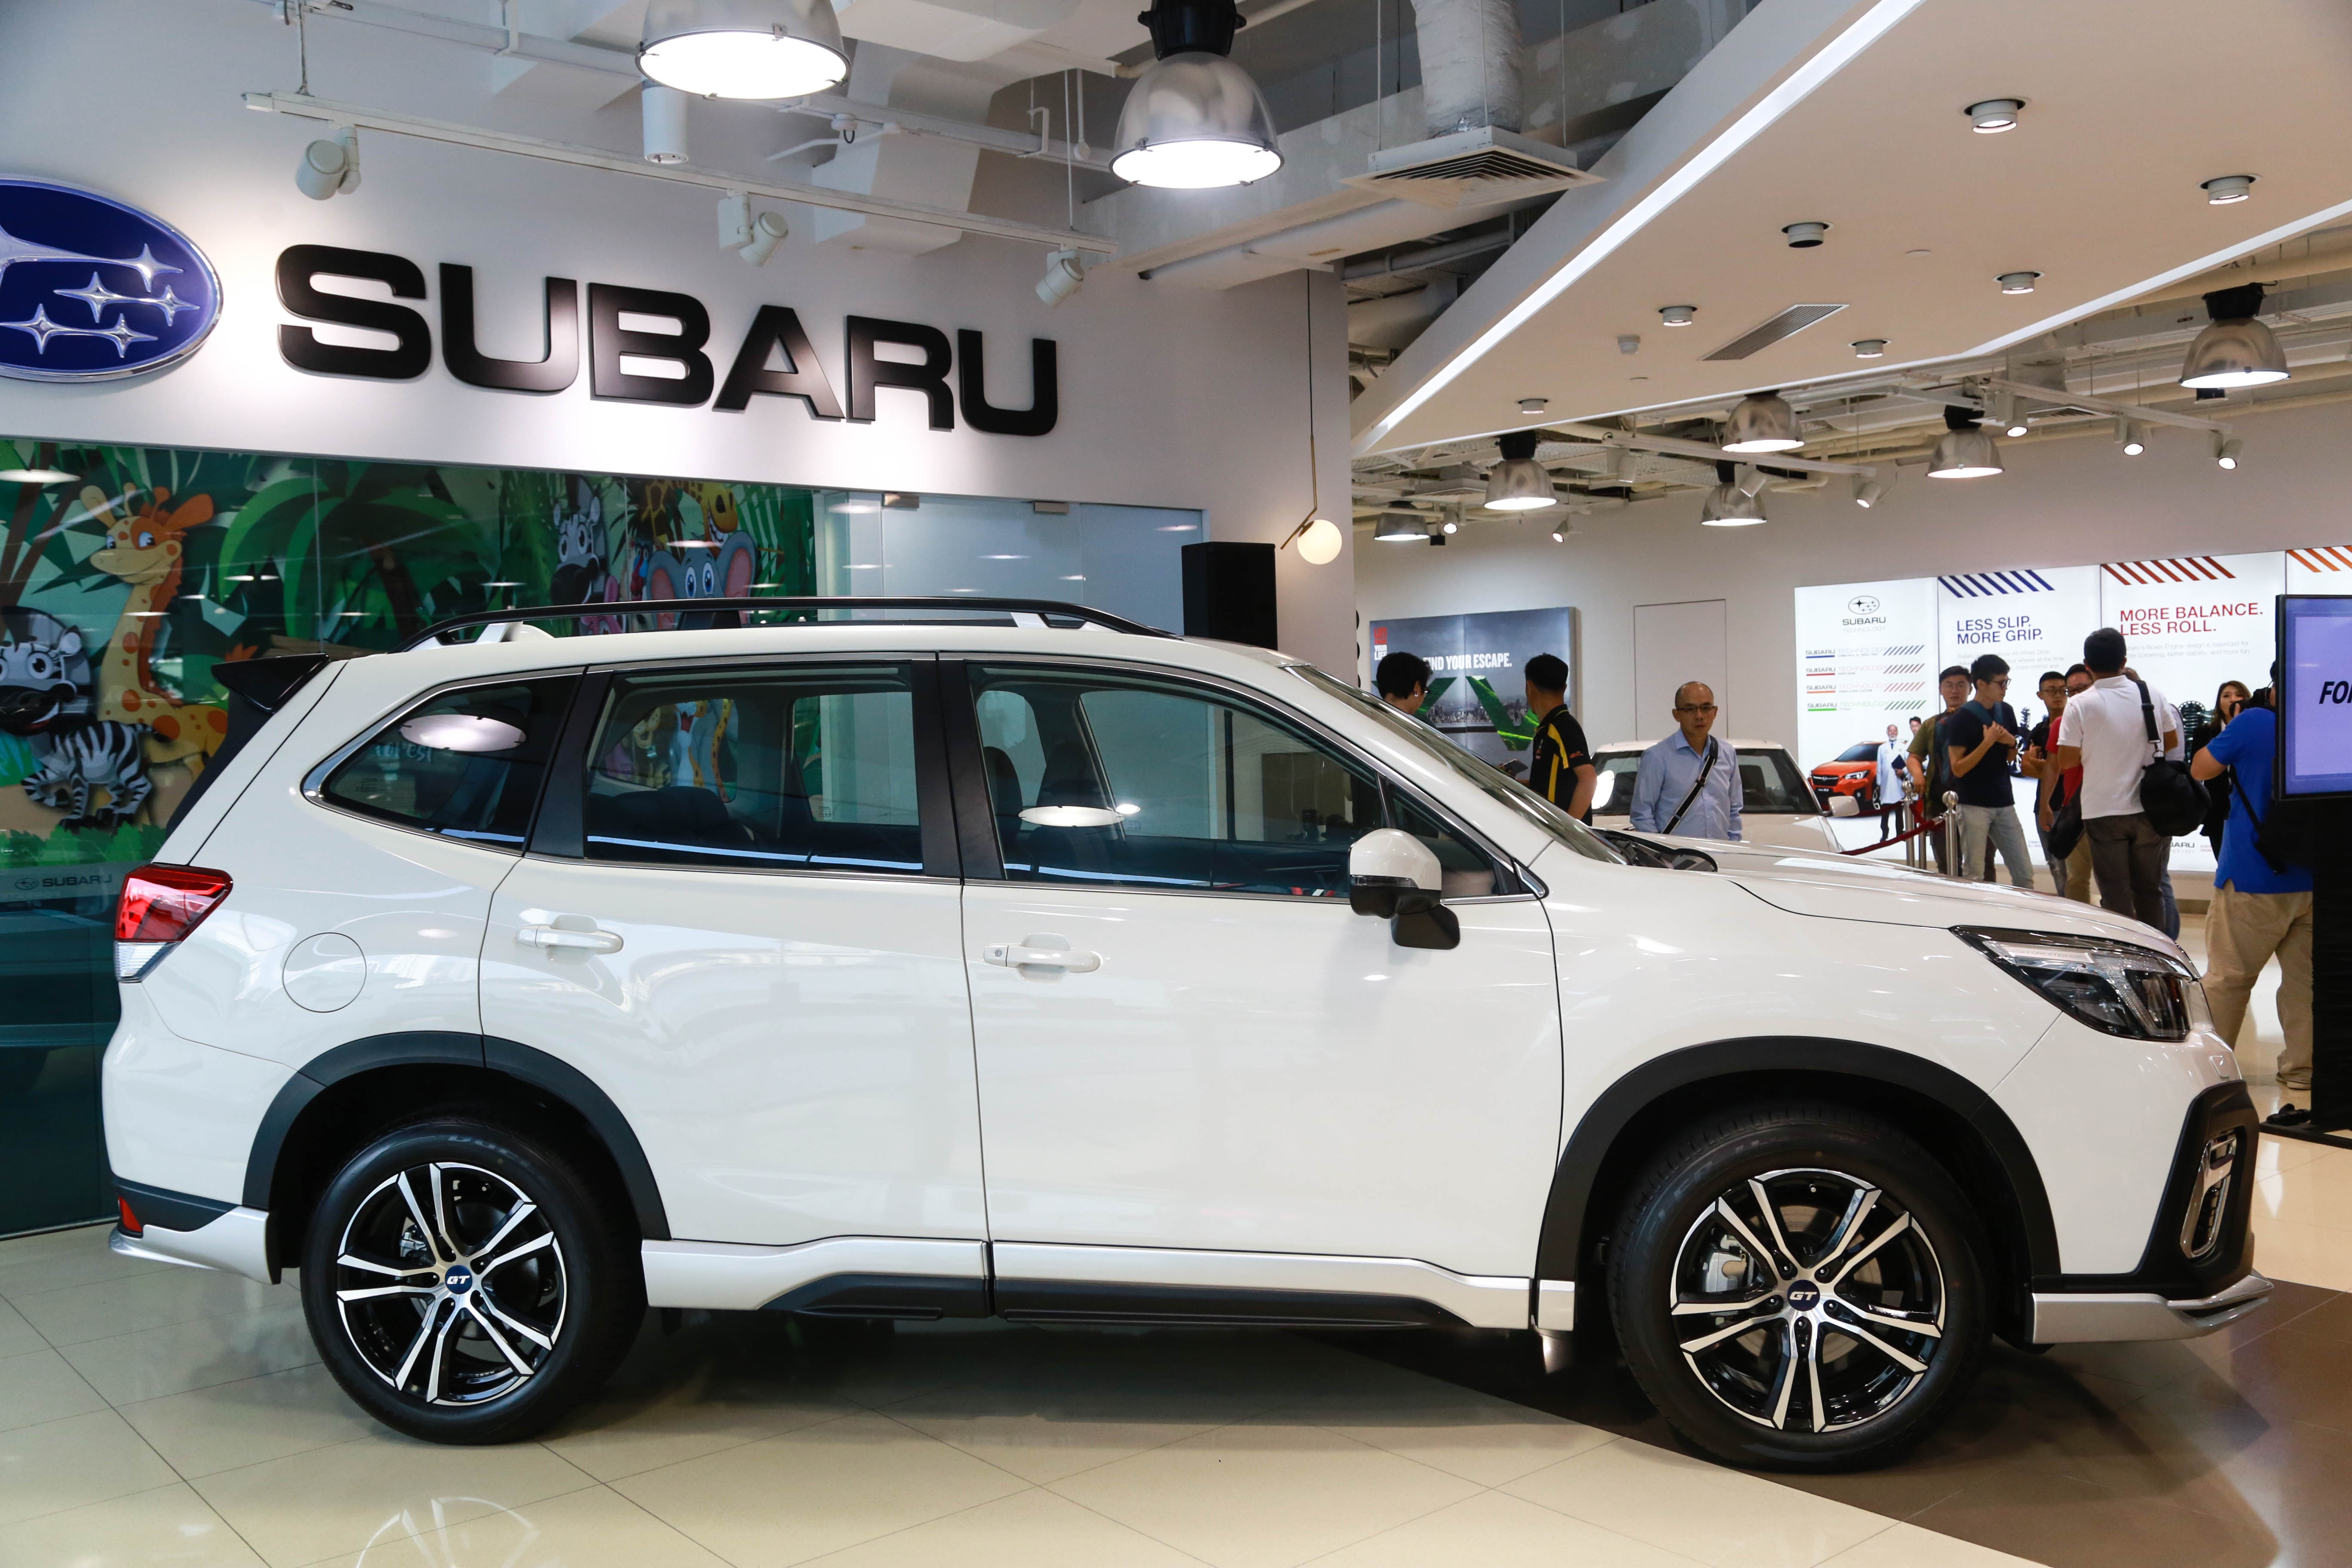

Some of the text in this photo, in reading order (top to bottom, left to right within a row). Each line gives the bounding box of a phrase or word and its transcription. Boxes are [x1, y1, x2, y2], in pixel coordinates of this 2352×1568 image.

[276, 243, 1058, 436] SUBARU
[1842, 616, 1886, 625] SUBARU
[2120, 603, 2263, 622] MORE BALANCE.
[1957, 616, 2031, 631] LESS SLIP.
[2120, 620, 2217, 636] LESS ROLL.
[1957, 628, 2043, 644] MORE GRIP.
[1446, 654, 1472, 671] YOUR
[1473, 652, 1512, 669] ESCAPE.
[2318, 680, 2352, 704] FO
[42, 874, 113, 887] SUBARU
[447, 1275, 471, 1285] GT
[1789, 1291, 1817, 1301] GT
